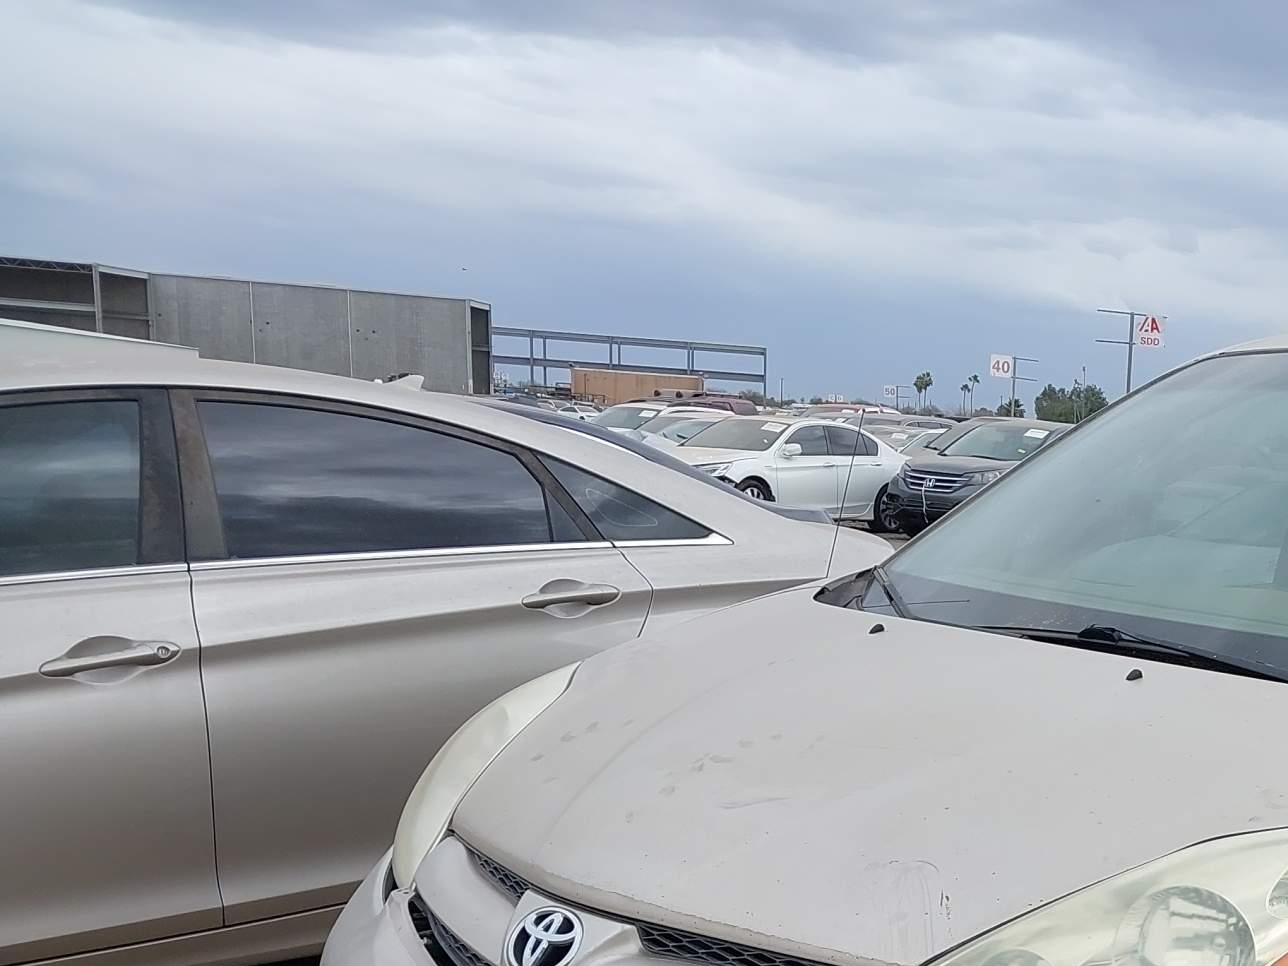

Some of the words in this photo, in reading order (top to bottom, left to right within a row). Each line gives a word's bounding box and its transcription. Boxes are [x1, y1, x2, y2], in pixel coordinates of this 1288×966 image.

[1140, 336, 1160, 347] SDD
[991, 359, 1011, 374] 40
[884, 387, 896, 396] 50
